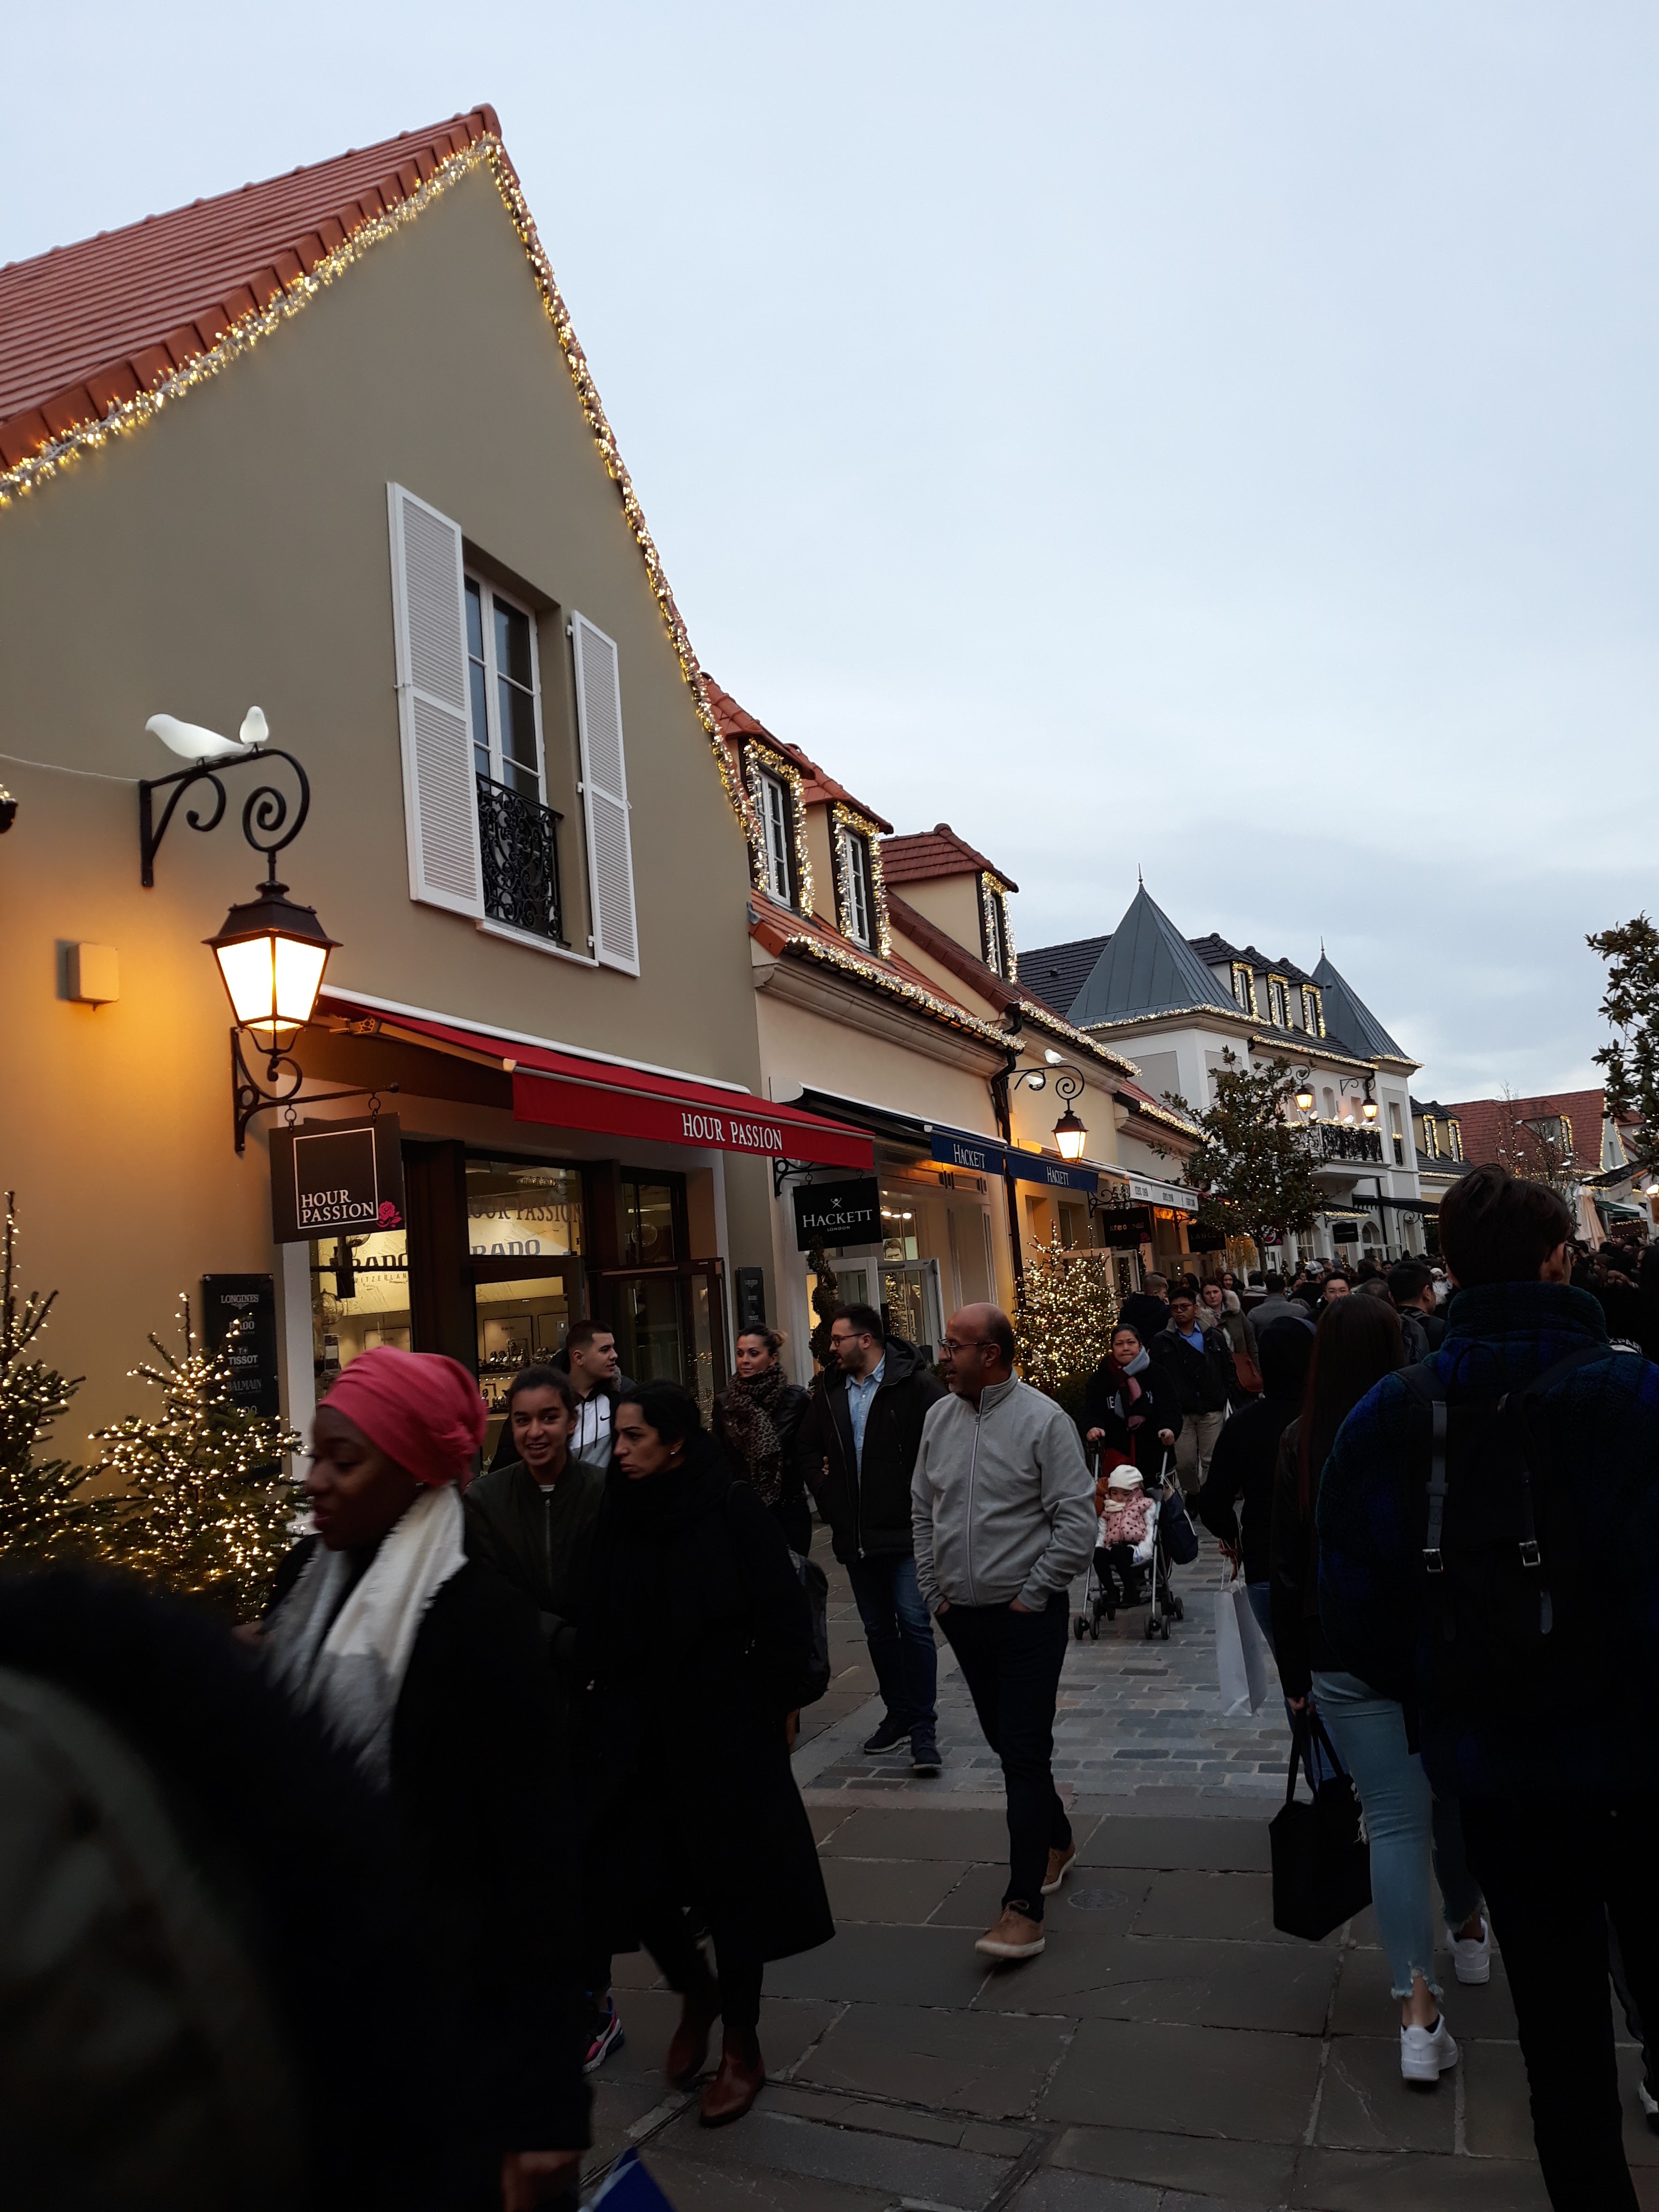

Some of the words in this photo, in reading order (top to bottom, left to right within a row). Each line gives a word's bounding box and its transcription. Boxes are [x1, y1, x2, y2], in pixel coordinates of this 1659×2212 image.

[682, 1113, 726, 1141] HOUR
[729, 1121, 782, 1150] PASSION
[953, 1144, 985, 1169] HACKETT
[301, 1189, 352, 1208] HOUR
[302, 1201, 374, 1223] PASSION
[803, 1209, 872, 1228] HACKETT
[221, 1294, 259, 1304] LONGINES
[229, 1320, 255, 1331] RDO
[228, 1355, 258, 1365] TISSOT
